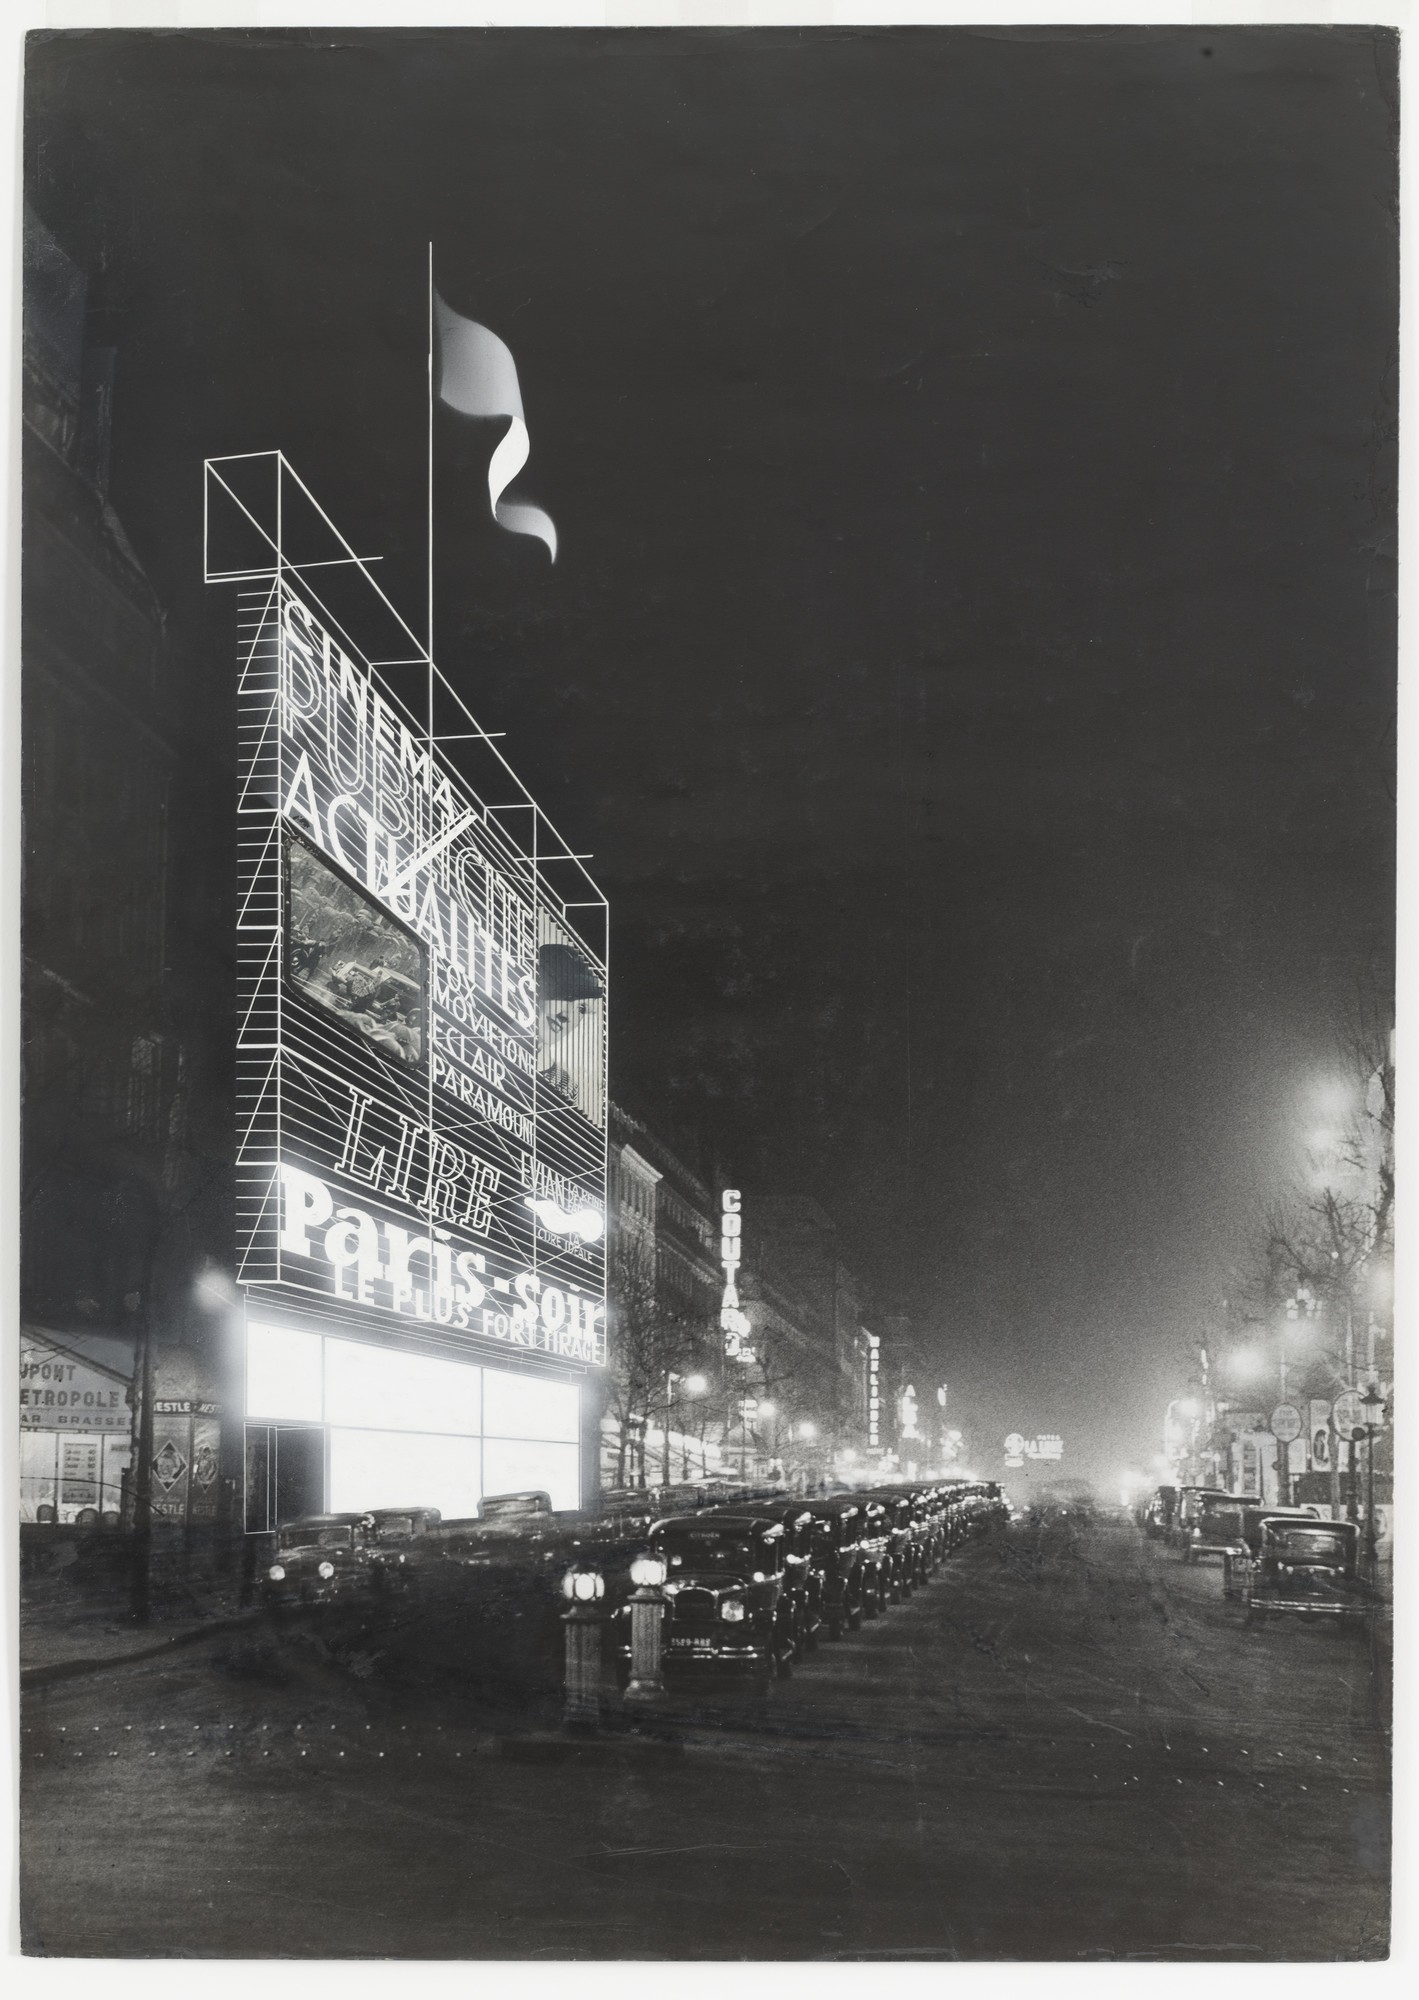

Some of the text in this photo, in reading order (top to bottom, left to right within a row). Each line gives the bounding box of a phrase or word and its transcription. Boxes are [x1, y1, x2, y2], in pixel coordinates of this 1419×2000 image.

[434, 946, 476, 1009] FOX
[432, 1012, 505, 1092] ECLAIR
[434, 975, 535, 1079] MOVIETONE
[433, 1053, 533, 1147] PARAMOUNT
[334, 1085, 501, 1238] LIRE
[521, 1150, 564, 1208] EVIAN
[334, 1260, 375, 1304] LE
[393, 1280, 472, 1329] PLUS
[482, 1309, 537, 1348] FORT
[58, 1415, 133, 1426] BRASSE
